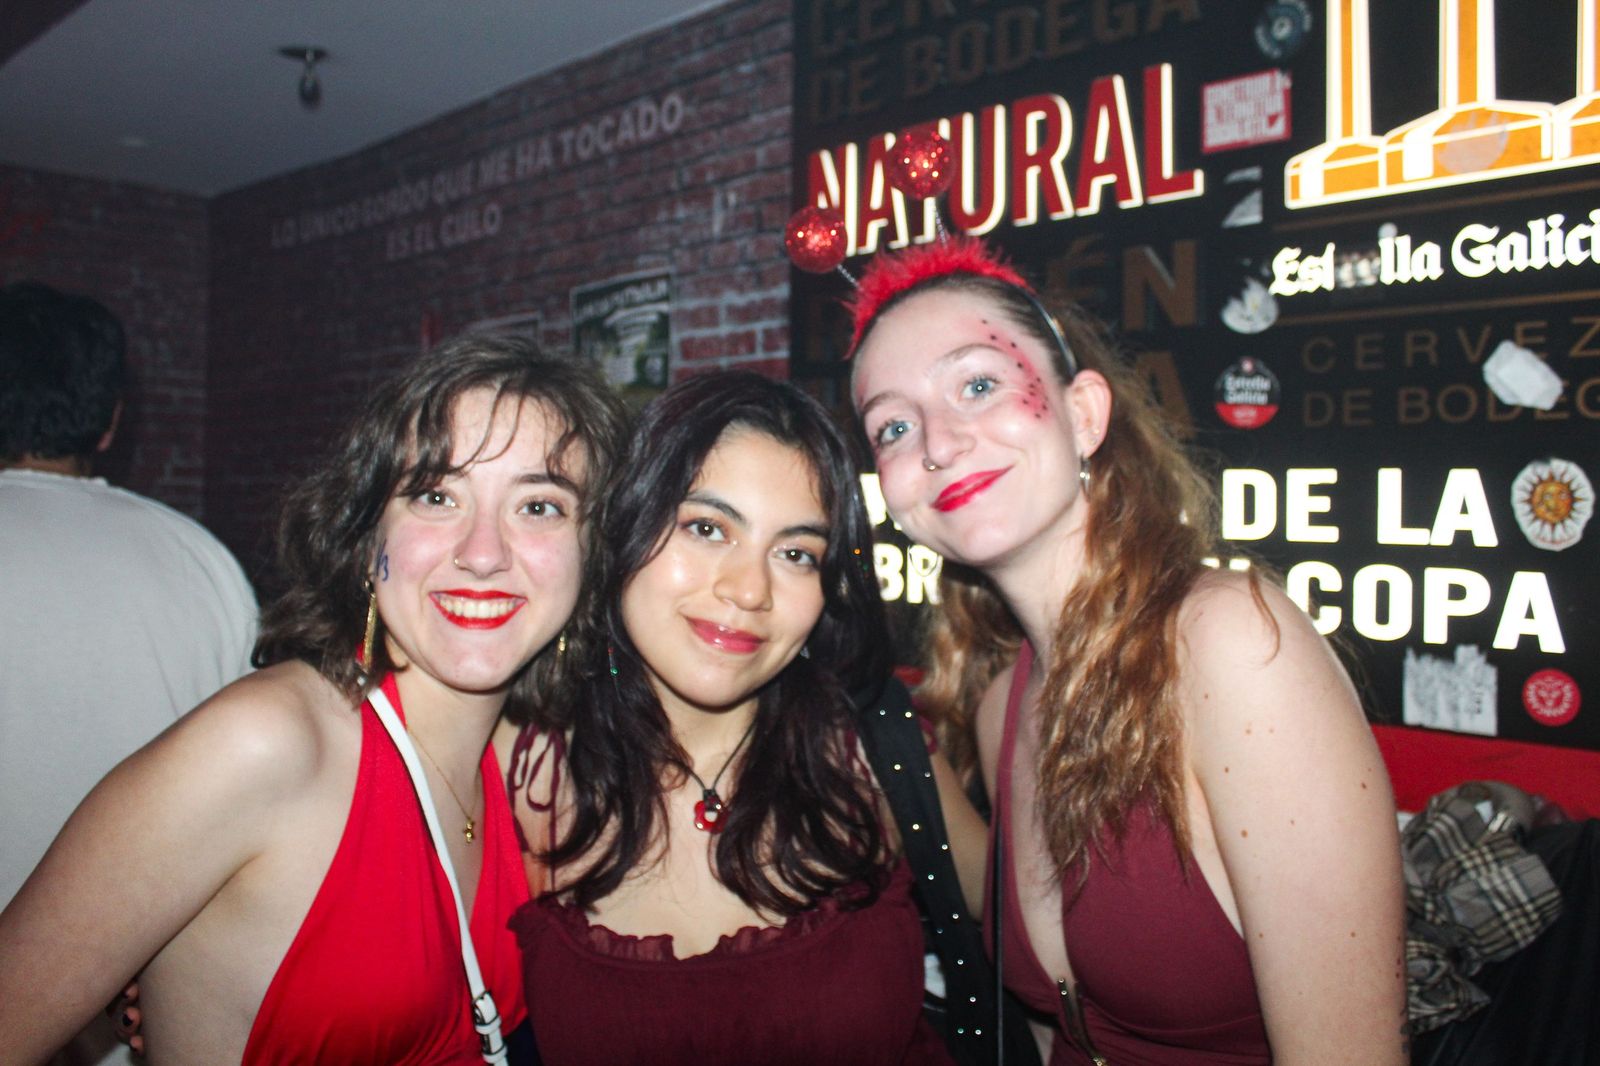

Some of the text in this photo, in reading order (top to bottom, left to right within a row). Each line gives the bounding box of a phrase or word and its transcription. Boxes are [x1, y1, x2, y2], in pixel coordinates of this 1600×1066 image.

[515, 136, 553, 182] HA
[558, 92, 685, 165] TOCADO
[440, 202, 501, 249] CULO
[1302, 388, 1376, 427] DE
[1222, 467, 1499, 548] DE LA
[1286, 560, 1566, 654] COPA
